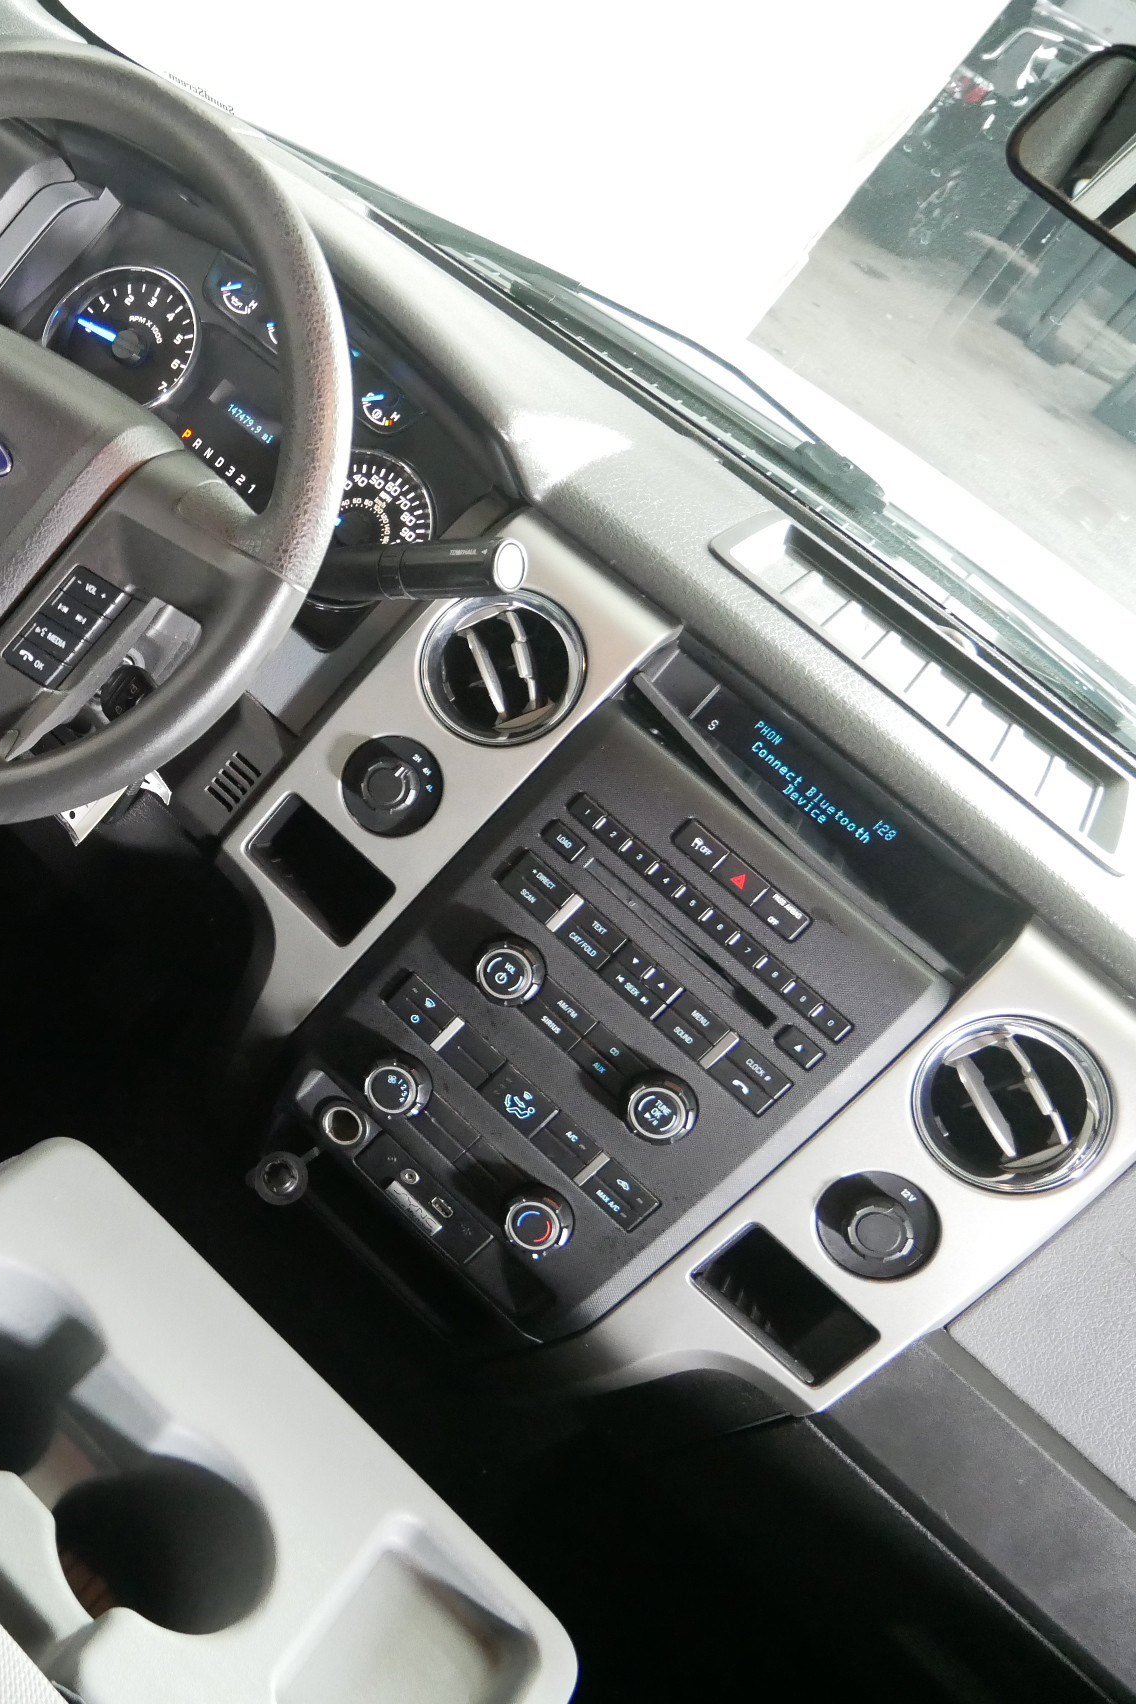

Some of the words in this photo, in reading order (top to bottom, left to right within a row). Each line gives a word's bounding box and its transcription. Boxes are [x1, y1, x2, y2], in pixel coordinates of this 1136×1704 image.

[124, 294, 135, 306] 2
[147, 297, 158, 308] 3
[103, 303, 110, 312] 1
[166, 312, 175, 322] 4
[129, 315, 146, 324] RPM
[150, 325, 163, 344] 1000
[173, 333, 184, 345] 5
[170, 359, 181, 370] 6
[158, 381, 168, 390] 7
[227, 404, 262, 434] 147479.9
[390, 411, 401, 422] H
[182, 428, 192, 438] P
[192, 437, 202, 450] R
[203, 447, 214, 459] N
[214, 456, 225, 468] D
[225, 465, 236, 477] 3
[235, 474, 246, 486] 2
[248, 484, 256, 494] 1
[353, 474, 368, 487] 40
[369, 475, 384, 489] 50
[385, 482, 401, 496] 60
[395, 496, 411, 510] 70
[400, 512, 416, 526] 80
[399, 527, 416, 542] 90
[85, 583, 97, 596] VOL
[47, 632, 66, 649] MEDIA
[34, 660, 45, 671] OK
[754, 720, 783, 746] PHON
[751, 741, 803, 787] Connect
[805, 786, 872, 844] Bluetooth
[782, 784, 828, 824] Device
[556, 834, 573, 849] LOAD
[700, 845, 712, 856] OFF
[535, 872, 556, 890] DIRECT
[520, 888, 537, 903] SCAN
[591, 920, 608, 935] TEXT
[767, 916, 780, 926] OFF
[568, 932, 597, 957] CAT/FOLD
[624, 982, 640, 997] SEEK
[556, 1000, 578, 1019] AM/FM
[541, 1015, 561, 1034] SIRIUS
[691, 1010, 710, 1027] MENU
[673, 1026, 694, 1044] SOUND
[609, 1047, 620, 1057] CD
[592, 1062, 606, 1073] AUX
[745, 1059, 765, 1077] CLOCK
[651, 1108, 663, 1119] OK
[655, 1099, 672, 1116] TUNE
[565, 1131, 578, 1142] A/C
[595, 1190, 610, 1203] MAX
[608, 1201, 621, 1212] A/C
[901, 1188, 917, 1202] 12V
